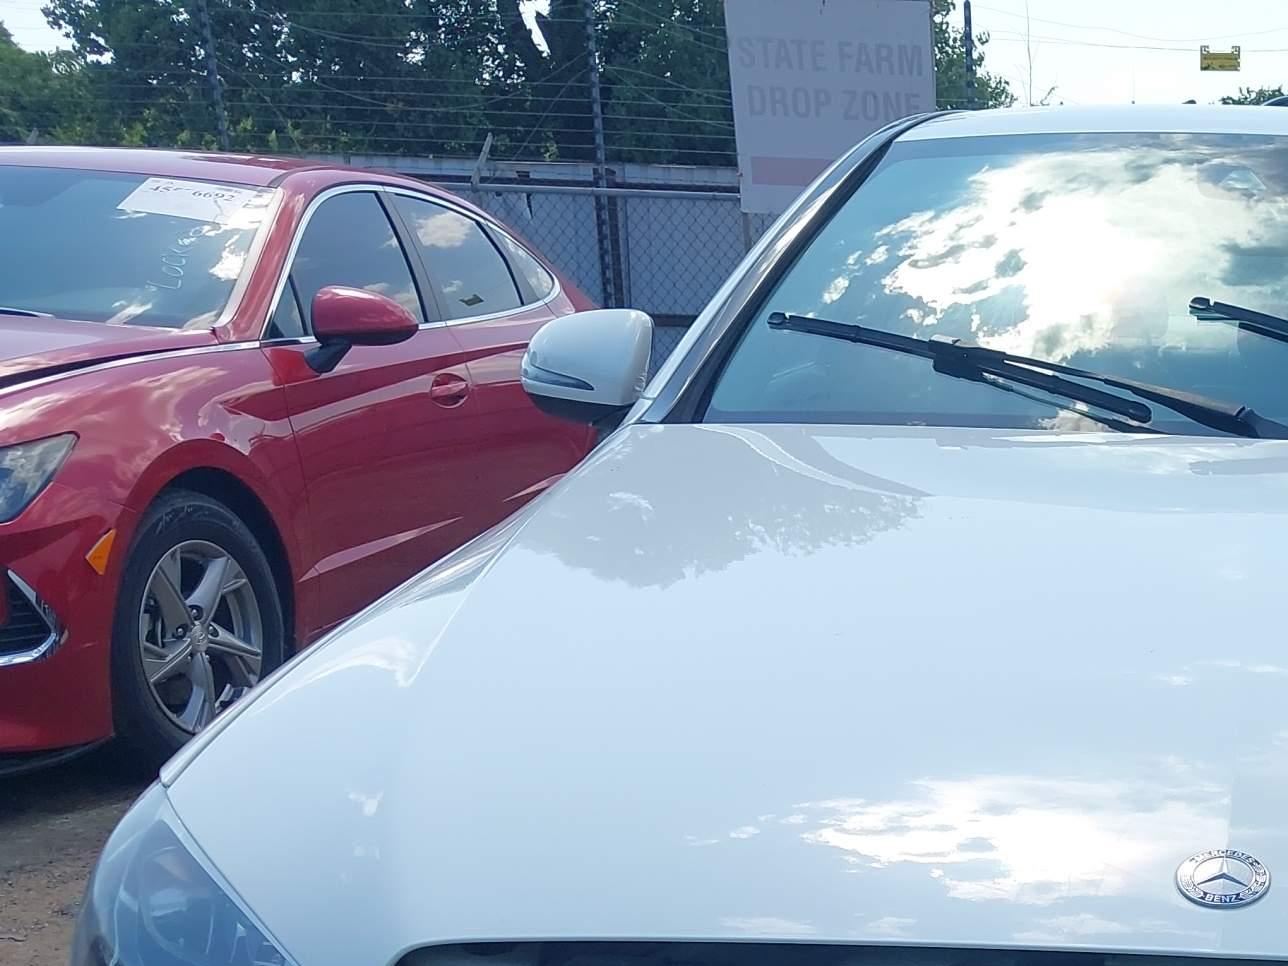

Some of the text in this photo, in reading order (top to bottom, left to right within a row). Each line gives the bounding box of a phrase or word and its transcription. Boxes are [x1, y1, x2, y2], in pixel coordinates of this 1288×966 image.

[737, 36, 924, 76] STATE FARM
[747, 84, 921, 121] DROP ZONE
[149, 183, 236, 202] 456692
[1204, 894, 1238, 904] BENZ
